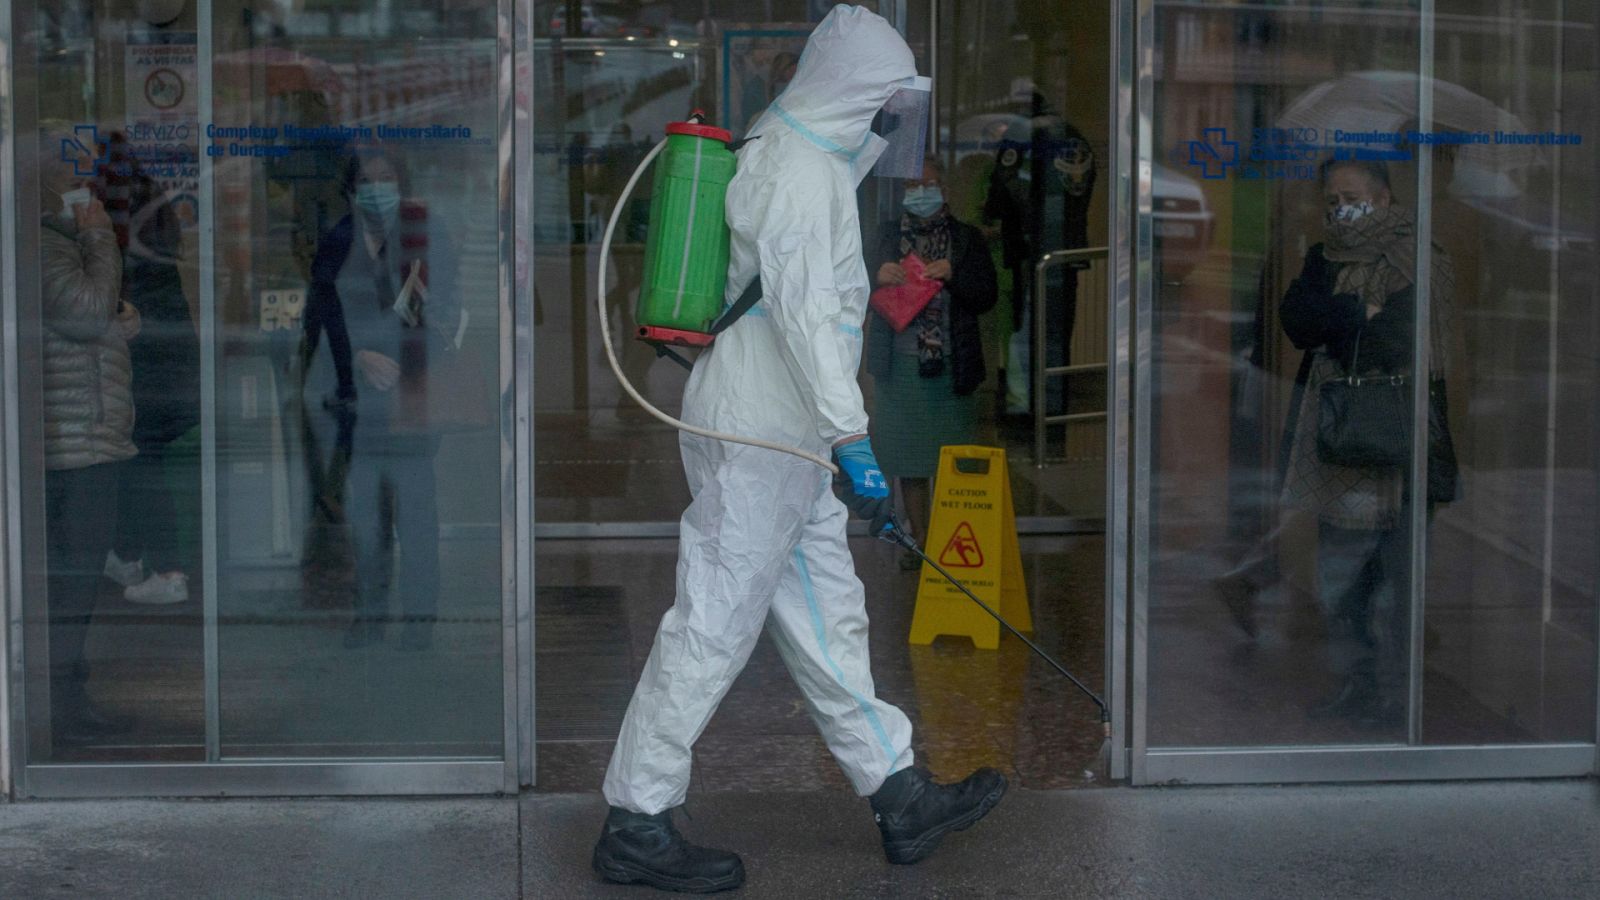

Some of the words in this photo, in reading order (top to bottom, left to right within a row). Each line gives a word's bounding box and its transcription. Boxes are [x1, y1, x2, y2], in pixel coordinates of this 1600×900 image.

[125, 124, 190, 140] SERVIZO
[207, 124, 278, 140] Complexo
[378, 125, 471, 138] Universitario
[1495, 131, 1582, 145] Universitario
[207, 143, 224, 156] de
[948, 488, 987, 496] CAUTION
[941, 501, 960, 509] WET
[963, 501, 993, 510] FLOOR
